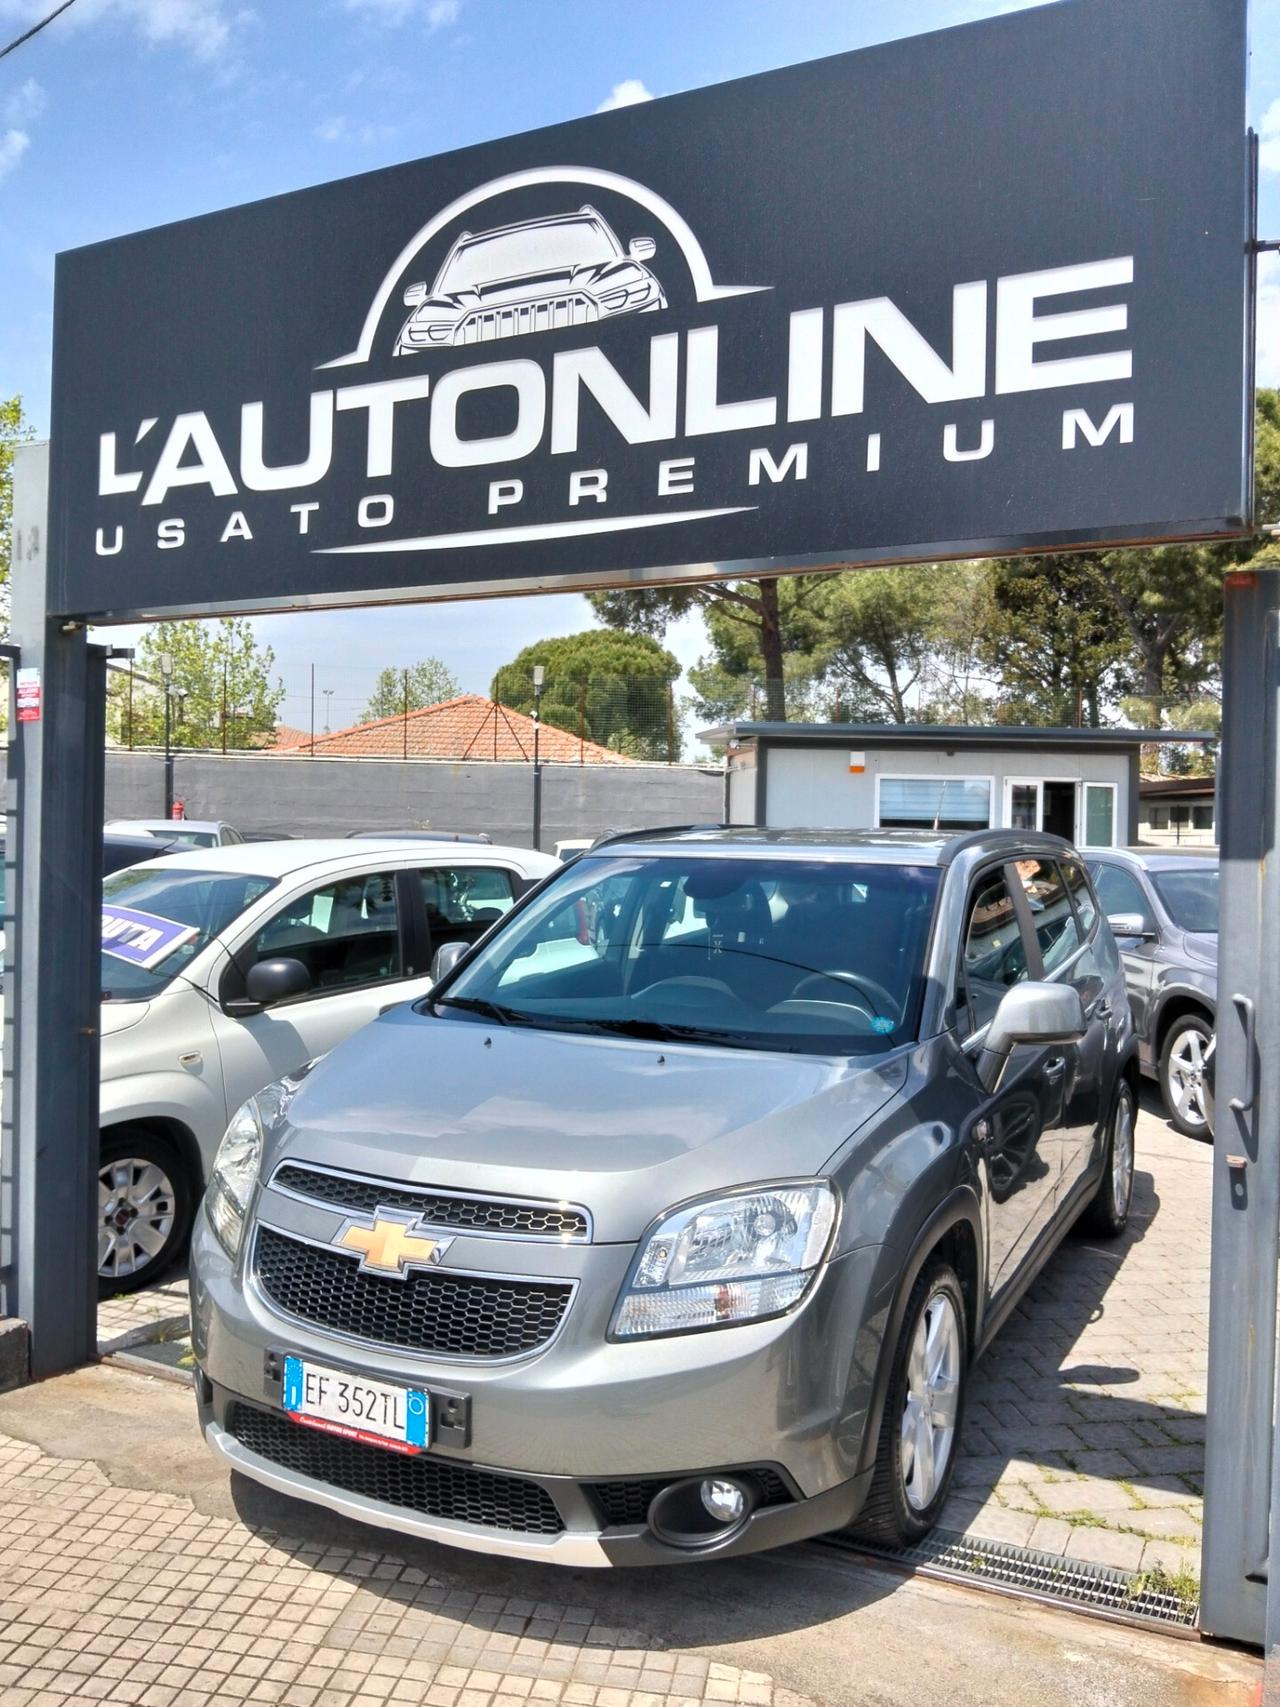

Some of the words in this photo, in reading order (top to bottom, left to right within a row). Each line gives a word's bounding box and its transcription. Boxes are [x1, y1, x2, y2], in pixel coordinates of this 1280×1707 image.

[98, 256, 1134, 506] L'AUTONLINE
[95, 494, 394, 556] USATO
[488, 402, 1134, 515] PREMIUM
[305, 1372, 330, 1406] EF
[338, 1382, 405, 1430] 352TL
